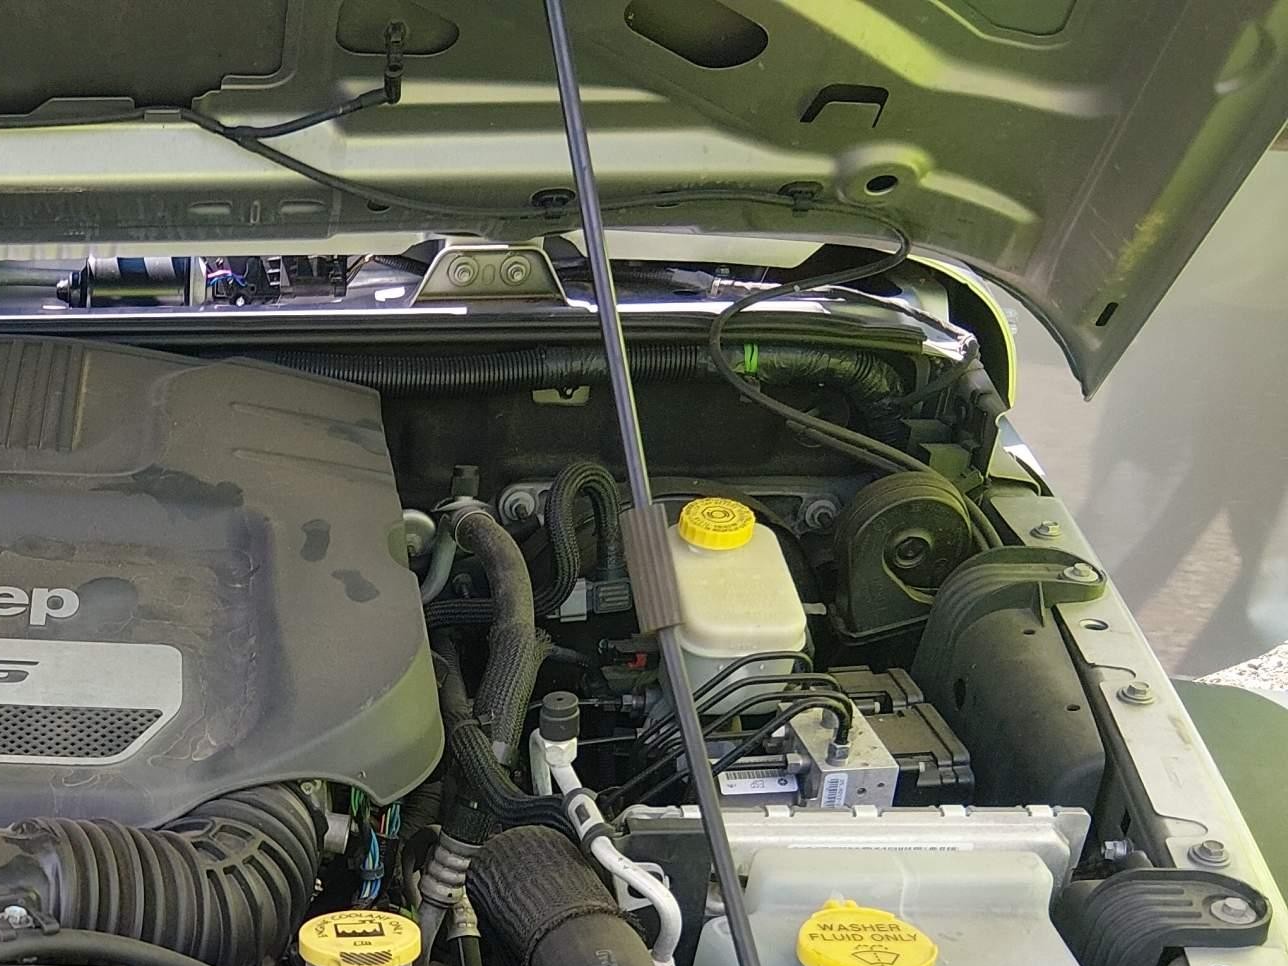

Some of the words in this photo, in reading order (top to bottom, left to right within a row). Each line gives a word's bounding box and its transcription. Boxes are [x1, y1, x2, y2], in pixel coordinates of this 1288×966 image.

[817, 923, 902, 932] WASHER
[808, 933, 864, 942] FLUID
[871, 933, 918, 942] ONLY
